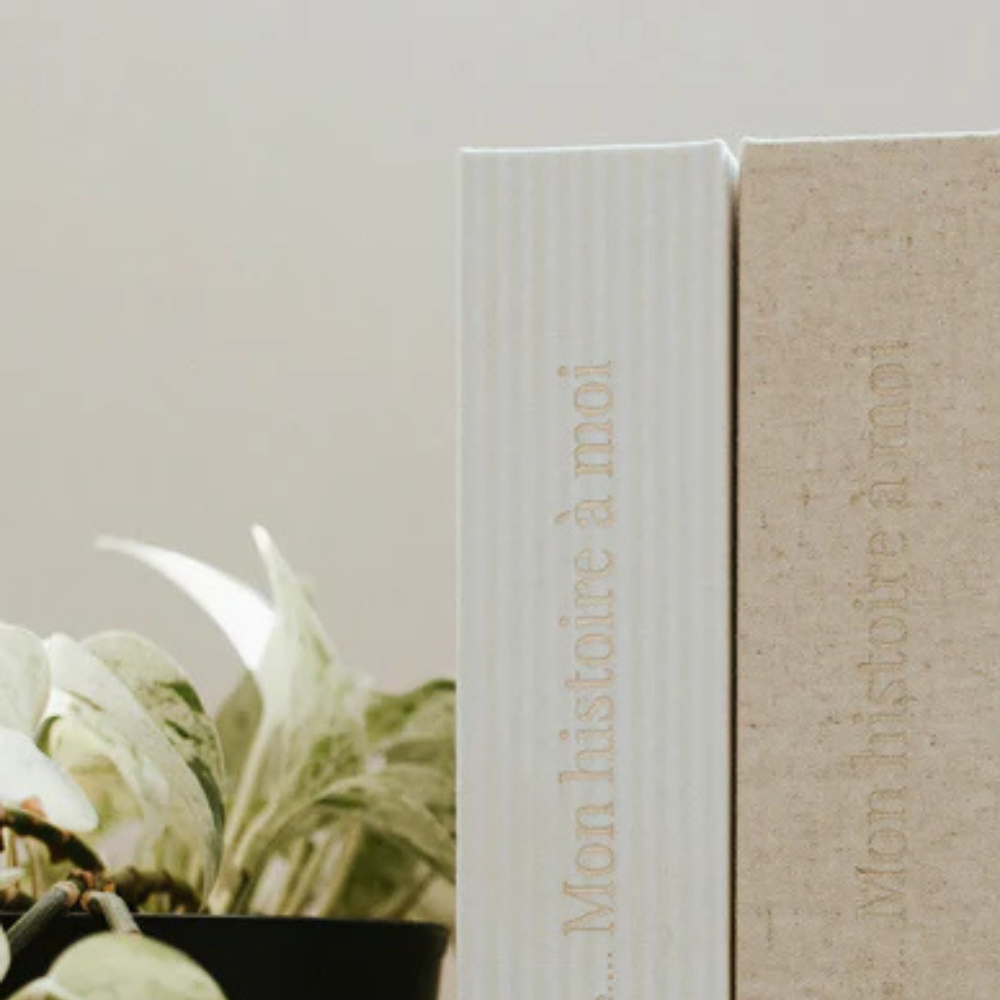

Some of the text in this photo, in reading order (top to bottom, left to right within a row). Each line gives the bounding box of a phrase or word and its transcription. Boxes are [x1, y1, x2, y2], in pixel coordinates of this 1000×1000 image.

[556, 359, 615, 479] moi
[553, 494, 615, 528] à
[557, 548, 615, 785] histoire
[850, 530, 908, 778] histoire
[560, 800, 615, 938] Mon
[854, 785, 908, 922] Mon
